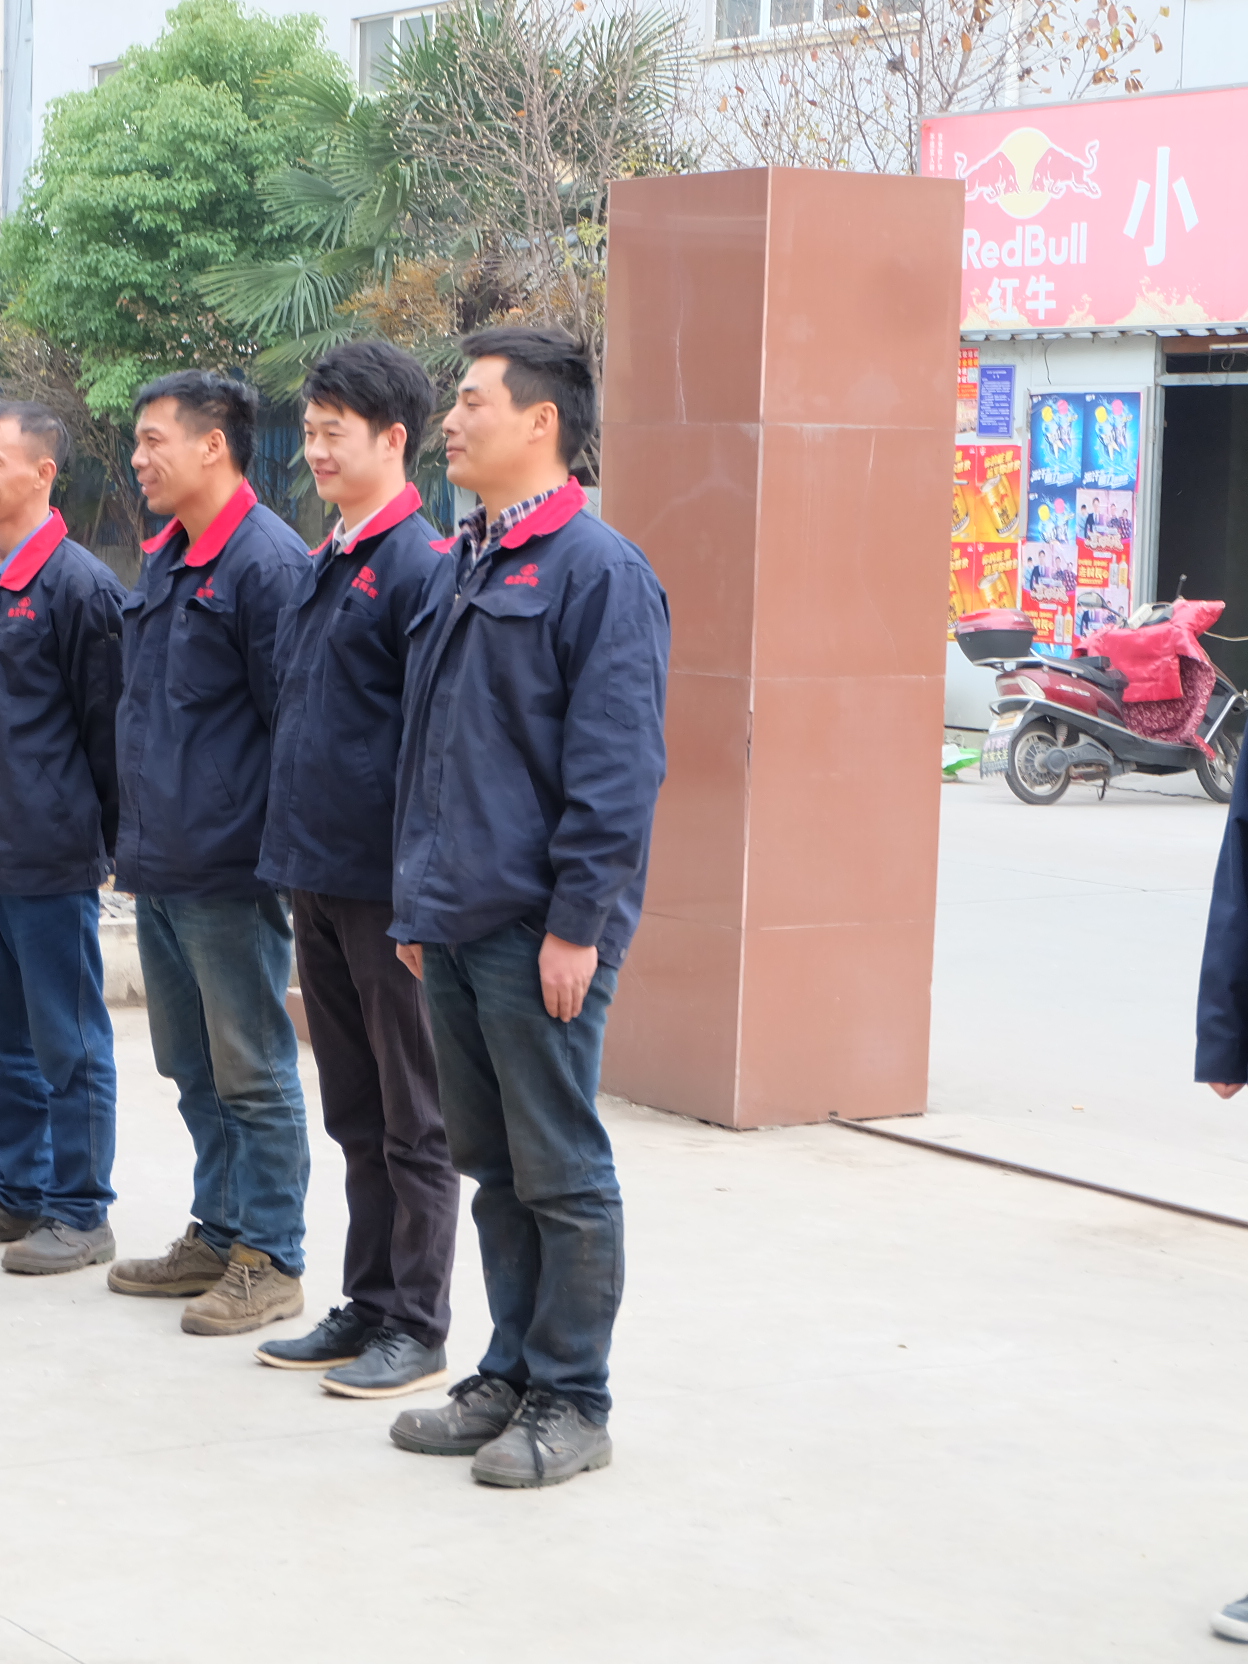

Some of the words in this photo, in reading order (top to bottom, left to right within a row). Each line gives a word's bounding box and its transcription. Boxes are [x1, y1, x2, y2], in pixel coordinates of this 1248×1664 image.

[1123, 146, 1199, 266] 小
[962, 222, 1088, 269] RedBull
[987, 274, 1056, 321] 红牛
